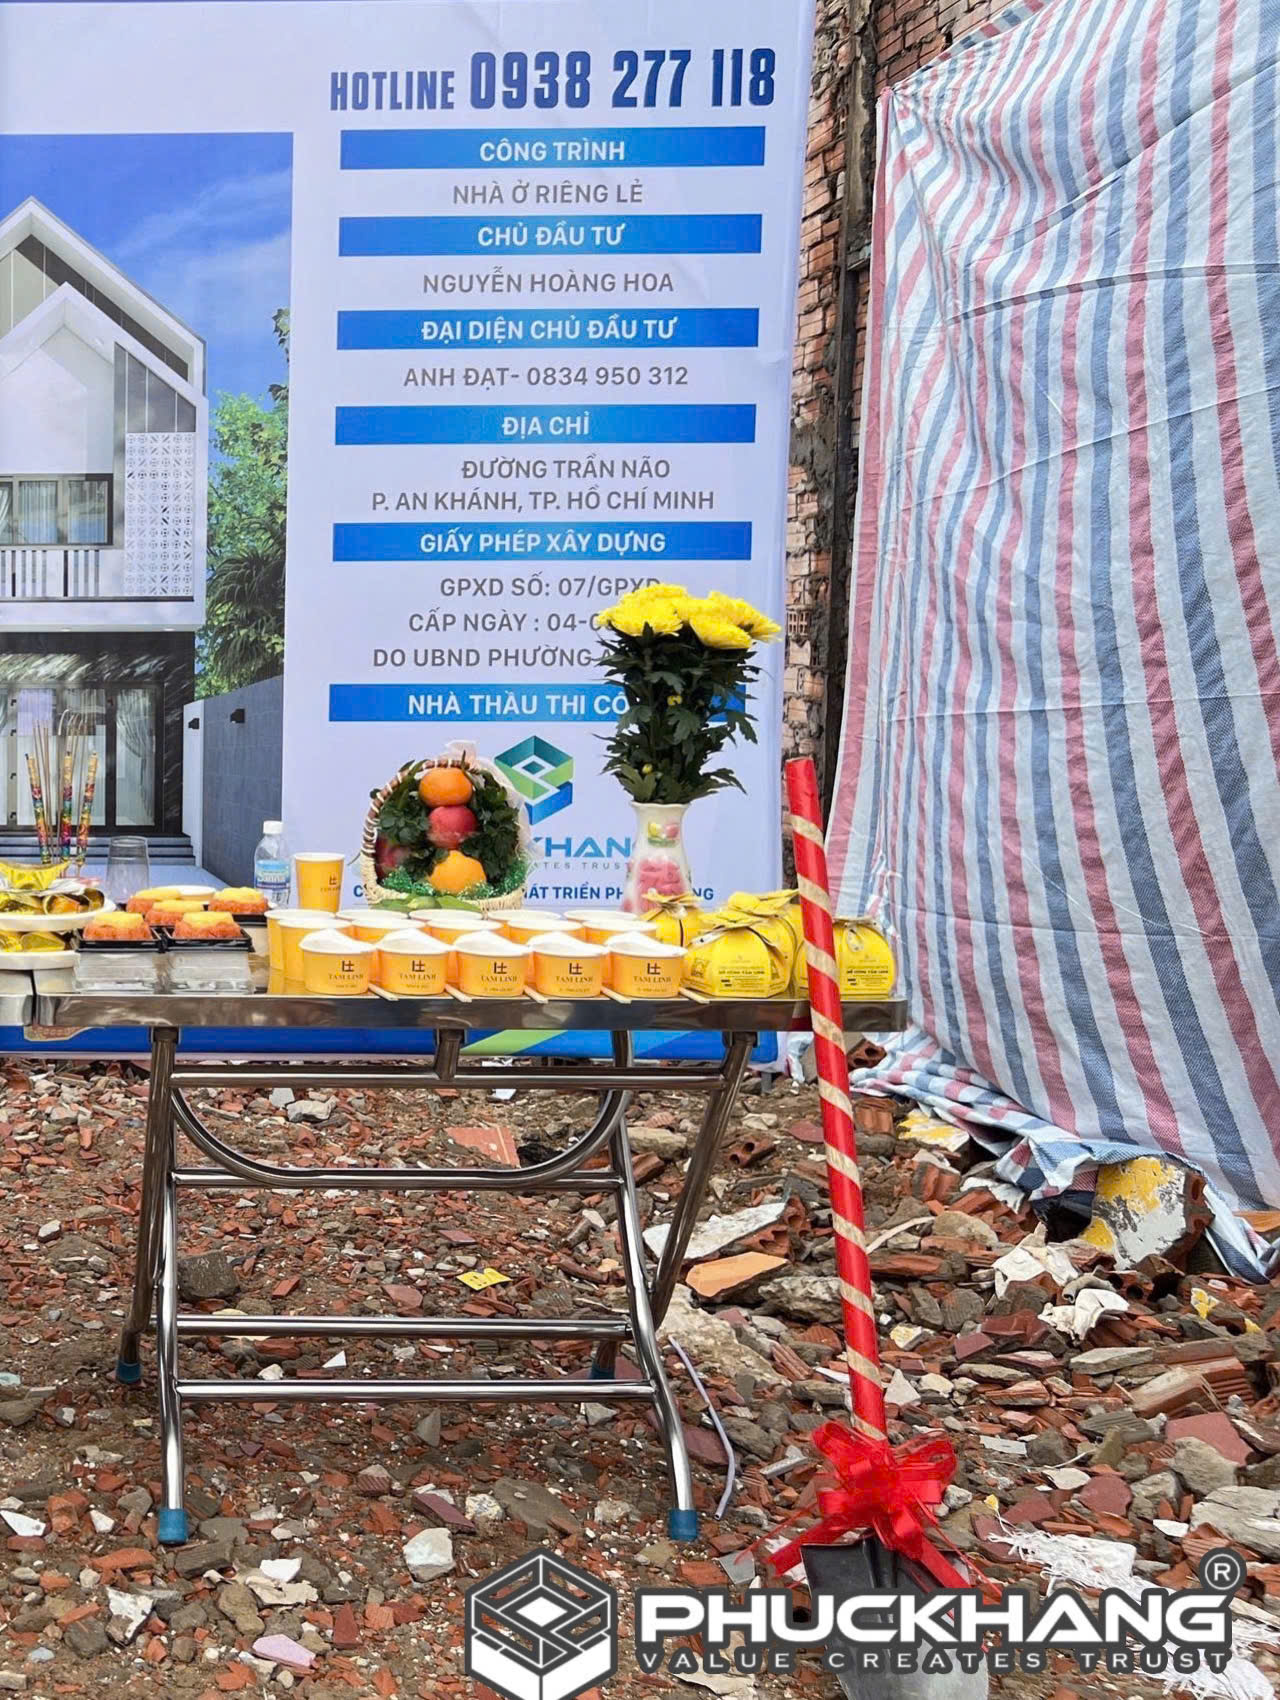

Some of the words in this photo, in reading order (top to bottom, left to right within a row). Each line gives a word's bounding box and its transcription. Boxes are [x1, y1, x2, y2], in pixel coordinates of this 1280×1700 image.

[330, 71, 455, 110] HOTLINE
[471, 51, 591, 109] 0938
[612, 50, 691, 107] 277
[712, 48, 776, 106] 118
[480, 138, 546, 161] CÔNG
[553, 138, 624, 160] TRÌNH
[454, 181, 504, 204] NHÀ
[512, 180, 529, 203] Ở
[536, 180, 608, 203] RIÊNG
[617, 179, 642, 203] LẺ
[478, 222, 527, 246] CHỦ
[535, 221, 584, 245] ĐẦU
[591, 223, 625, 245] TƯ
[424, 266, 521, 293] NGUYỄN
[531, 270, 615, 292] HOÀNG
[624, 273, 673, 292] HOA
[421, 321, 461, 343] ĐẠI
[469, 316, 522, 343] DIỆN
[531, 315, 580, 339] CHỦ
[587, 313, 636, 338] ĐẦU
[643, 317, 677, 338] TƯ
[404, 368, 454, 386] ANH
[463, 368, 519, 390] ĐẠT-
[527, 367, 587, 385] 0834
[596, 367, 640, 385] 950
[649, 367, 687, 385] 312
[502, 417, 542, 439] ĐỊA
[550, 411, 589, 435] CHỈ
[461, 456, 547, 478] ĐƯỜNG
[553, 453, 614, 478] TRẦN
[622, 456, 669, 478] NÃO
[373, 493, 389, 510] P.
[396, 493, 427, 510] AN
[435, 487, 522, 513] KHÁNH,
[529, 492, 560, 509] TP.
[568, 485, 600, 509] HỒ
[607, 487, 647, 509] CHÍ
[654, 491, 713, 509] MINH
[421, 528, 473, 552] GIẤY
[480, 529, 541, 552] PHÉP
[547, 529, 591, 552] XÂY
[598, 531, 665, 555] DỰNG
[441, 578, 503, 596] GPXD
[512, 572, 549, 596] SỐ:
[409, 607, 456, 631] CẤP
[464, 609, 526, 631] NGÀY
[534, 614, 540, 632] :
[548, 612, 615, 632] 04-0
[374, 649, 405, 666] DO
[414, 649, 480, 666] UBND
[488, 642, 592, 668] PHƯỜNG
[409, 692, 461, 714] NHÀ
[471, 691, 537, 714] THẦU
[546, 695, 585, 714] THI
[593, 690, 630, 715] CÔ
[553, 881, 600, 899] TRIỂN
